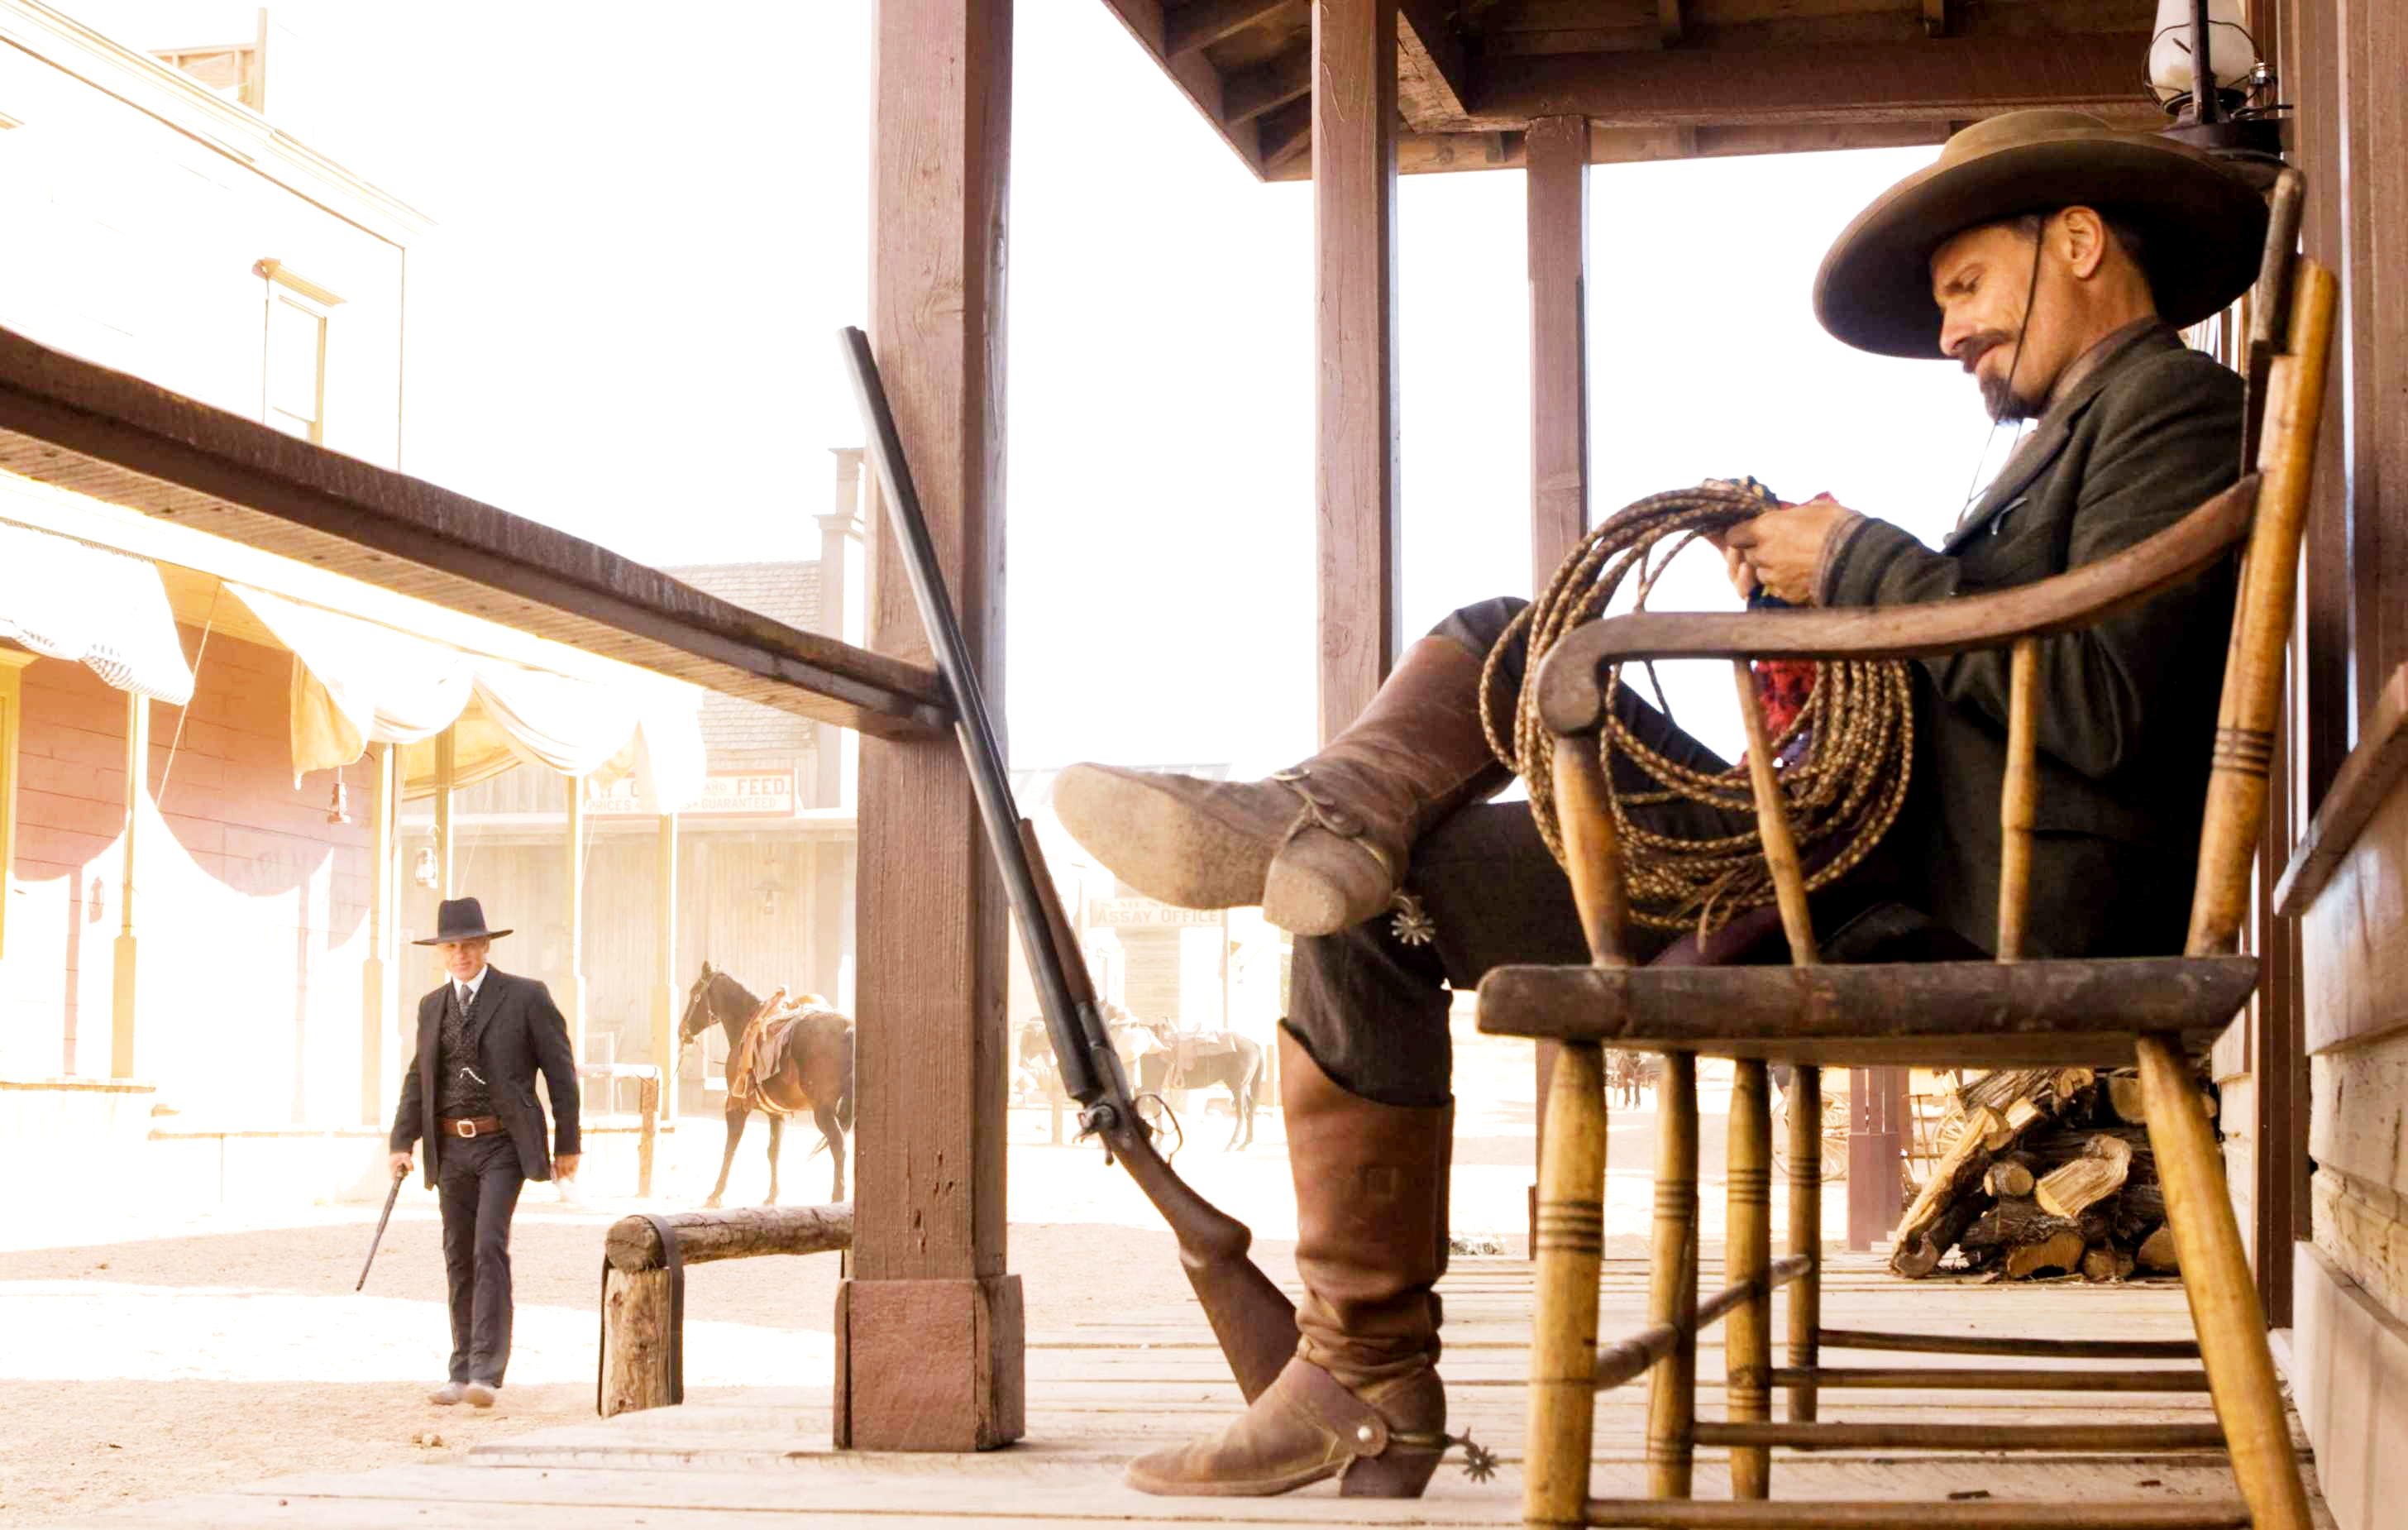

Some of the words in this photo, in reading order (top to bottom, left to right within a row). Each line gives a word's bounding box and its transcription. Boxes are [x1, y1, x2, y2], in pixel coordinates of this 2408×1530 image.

[738, 778, 790, 796] FEED.
[588, 800, 631, 811] PRICES
[701, 797, 776, 810] GUARANTEED
[1097, 909, 1152, 923] ASSAY
[1161, 908, 1219, 923] OFFICE
